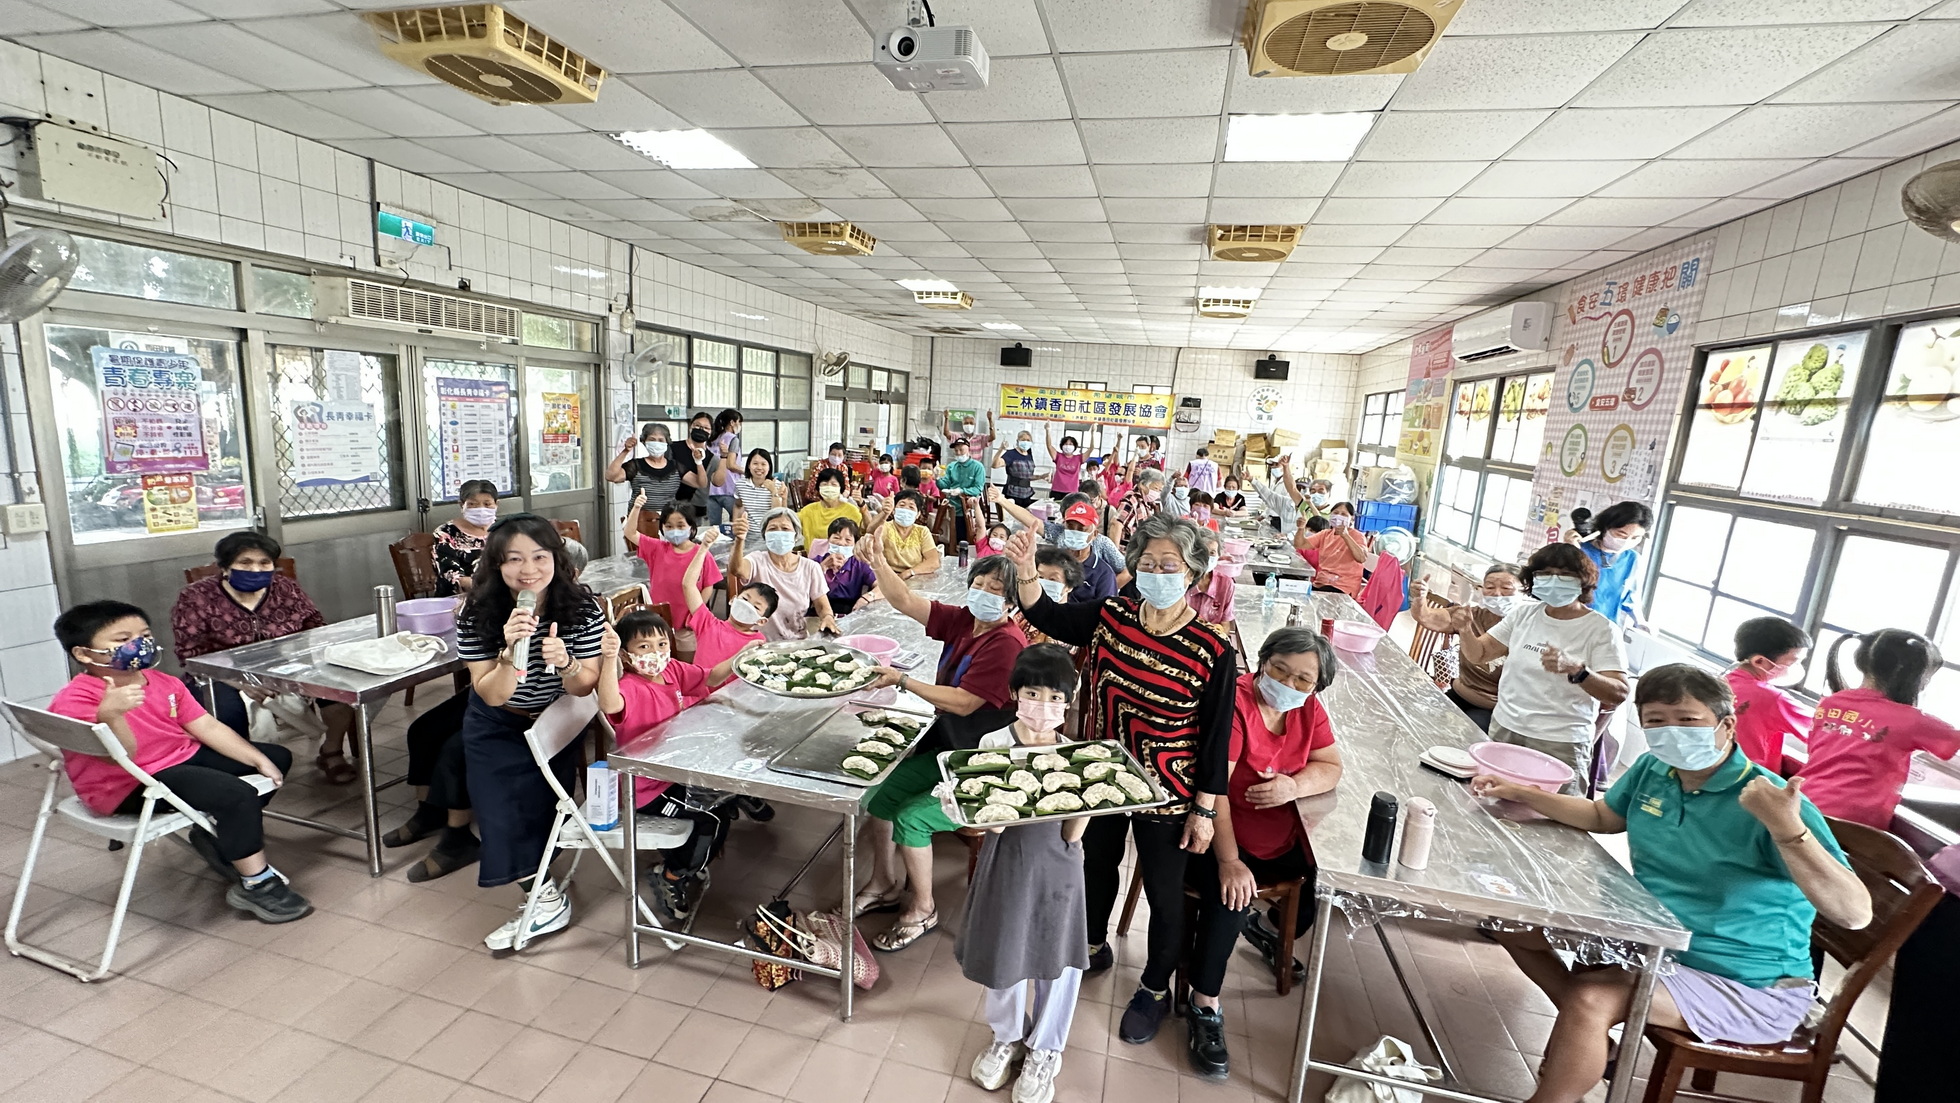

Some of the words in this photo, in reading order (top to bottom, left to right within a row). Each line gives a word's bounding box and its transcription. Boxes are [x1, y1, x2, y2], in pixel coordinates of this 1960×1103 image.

[1576, 281, 1629, 314] 食安五環
[102, 366, 197, 391] 青春專案
[1006, 394, 1168, 419] 二林鎮香田社區發展協會
